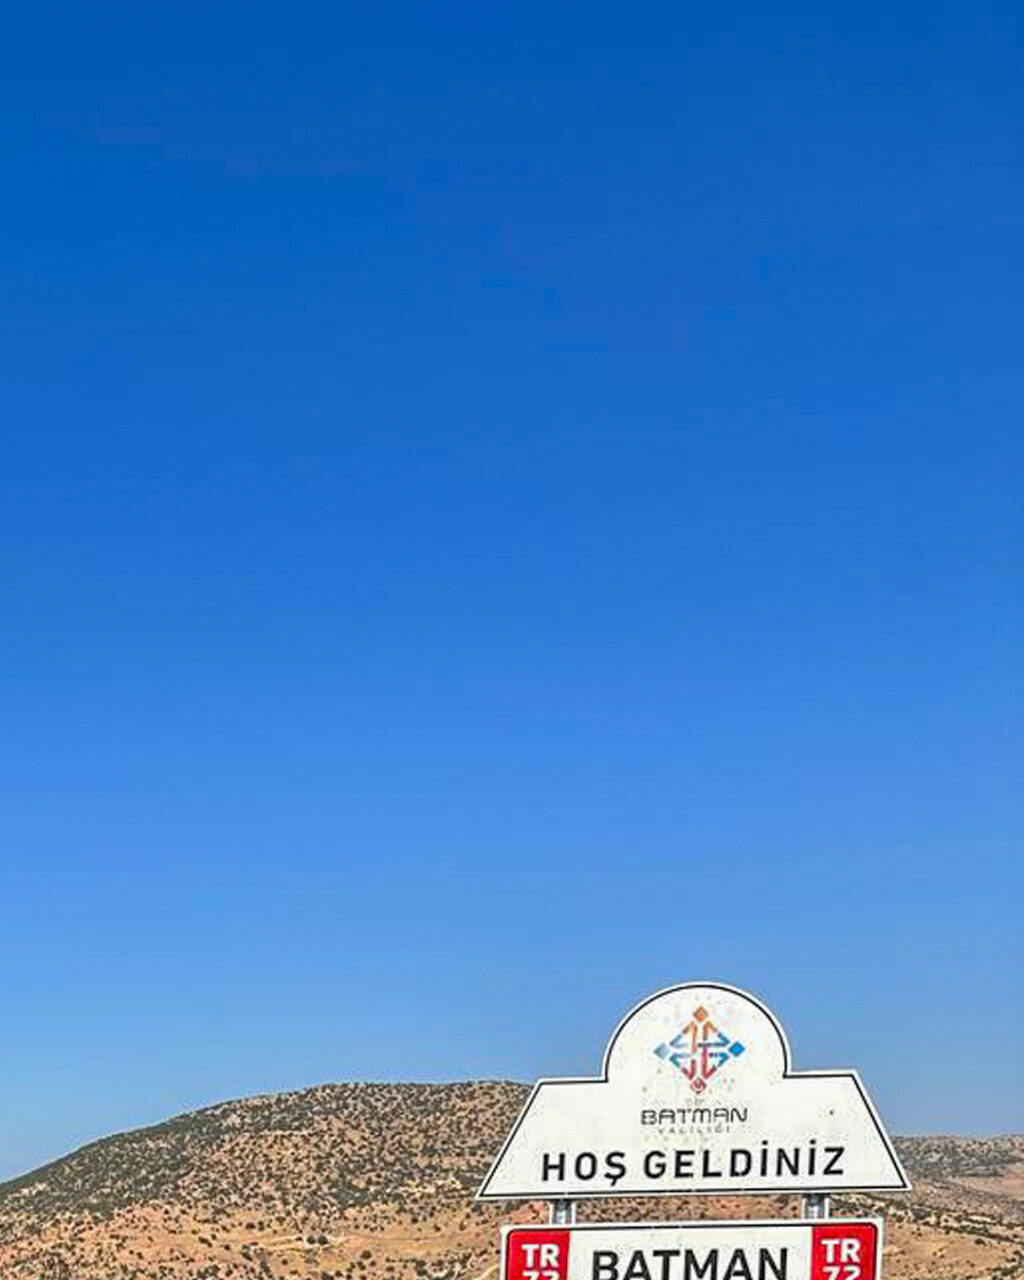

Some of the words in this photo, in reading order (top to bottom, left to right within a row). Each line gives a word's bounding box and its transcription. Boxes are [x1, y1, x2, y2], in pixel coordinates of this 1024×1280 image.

[640, 1107, 748, 1125] BATMAN
[542, 1151, 627, 1187] HOŞ
[644, 1139, 846, 1179] GELDİNİZ
[521, 1243, 560, 1269] TR
[821, 1238, 862, 1264] TR
